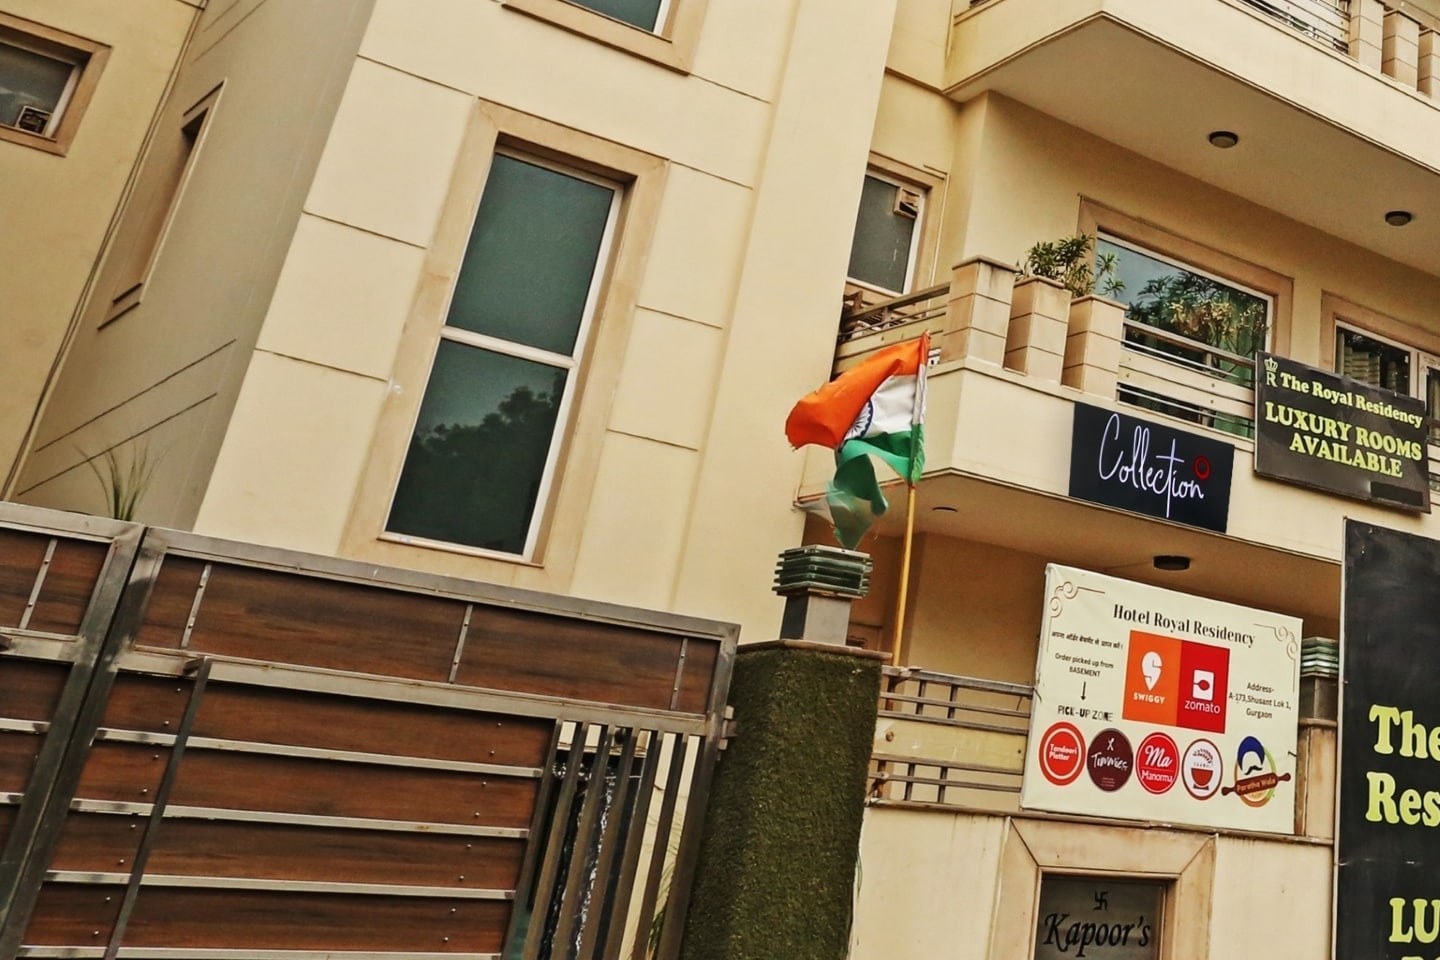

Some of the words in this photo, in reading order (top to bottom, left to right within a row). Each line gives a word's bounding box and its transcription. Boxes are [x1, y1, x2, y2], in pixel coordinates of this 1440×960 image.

[1280, 372, 1309, 393] The
[1312, 381, 1353, 406] Royal
[1355, 394, 1423, 429] Residency
[1265, 401, 1352, 442] LUXURY
[1355, 426, 1423, 461] ROOMS
[1098, 412, 1204, 518] Collection
[1289, 433, 1404, 478] AVAILABLE
[1113, 604, 1150, 625] Hotel
[1154, 612, 1190, 633] Royal
[1193, 620, 1255, 648] Residency
[1055, 652, 1072, 661] Order
[1072, 656, 1091, 665] picked
[1092, 659, 1100, 667] up
[1100, 660, 1114, 669] from
[1069, 666, 1101, 677] BASEMENT
[1133, 692, 1166, 704] SWIGGY
[1184, 700, 1221, 714] zomato
[1273, 699, 1285, 708] Lok
[1092, 710, 1114, 722] ZONE
[1246, 708, 1272, 719] Gurgaon
[1144, 745, 1173, 767] Ma
[1043, 912, 1150, 957] Kapoor's
